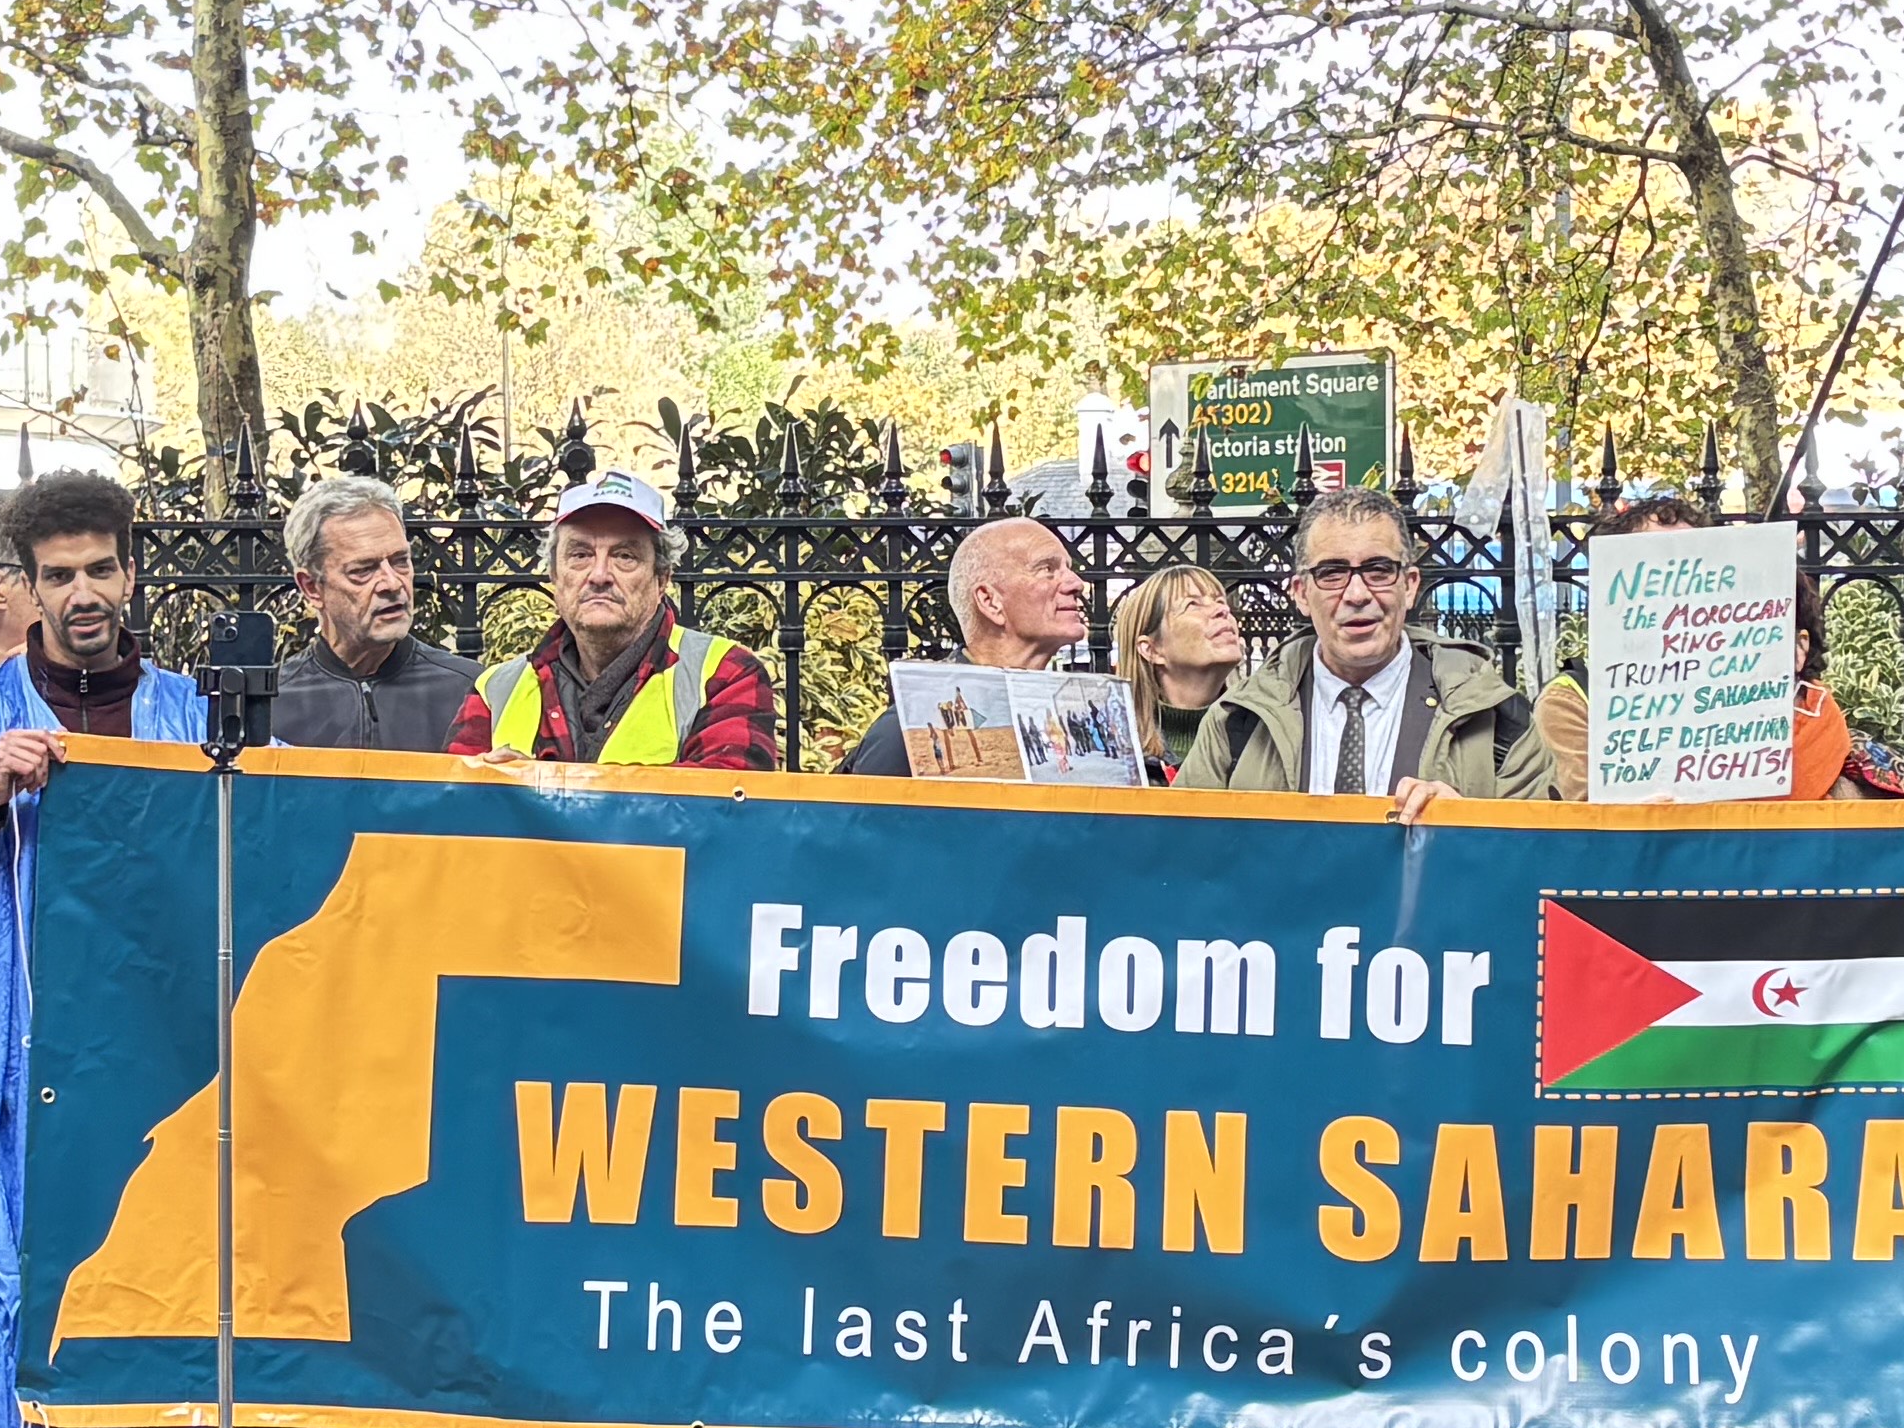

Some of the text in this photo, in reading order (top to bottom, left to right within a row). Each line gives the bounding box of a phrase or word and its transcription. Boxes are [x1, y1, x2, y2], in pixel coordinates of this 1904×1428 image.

[1193, 373, 1379, 401] arliament Square
[1193, 435, 1270, 458] ictoria
[1662, 597, 1792, 631] MOROCCAN
[1729, 625, 1784, 649] NOR
[1605, 652, 1761, 689] TRUMP CAN
[1607, 692, 1685, 721] DENY
[1604, 726, 1674, 756] SELF
[747, 903, 1492, 1046] Freedom for
[517, 1083, 1247, 1254] WESTERN
[583, 1280, 744, 1355] The
[802, 1285, 970, 1364] last
[1450, 1314, 1761, 1406] colony
